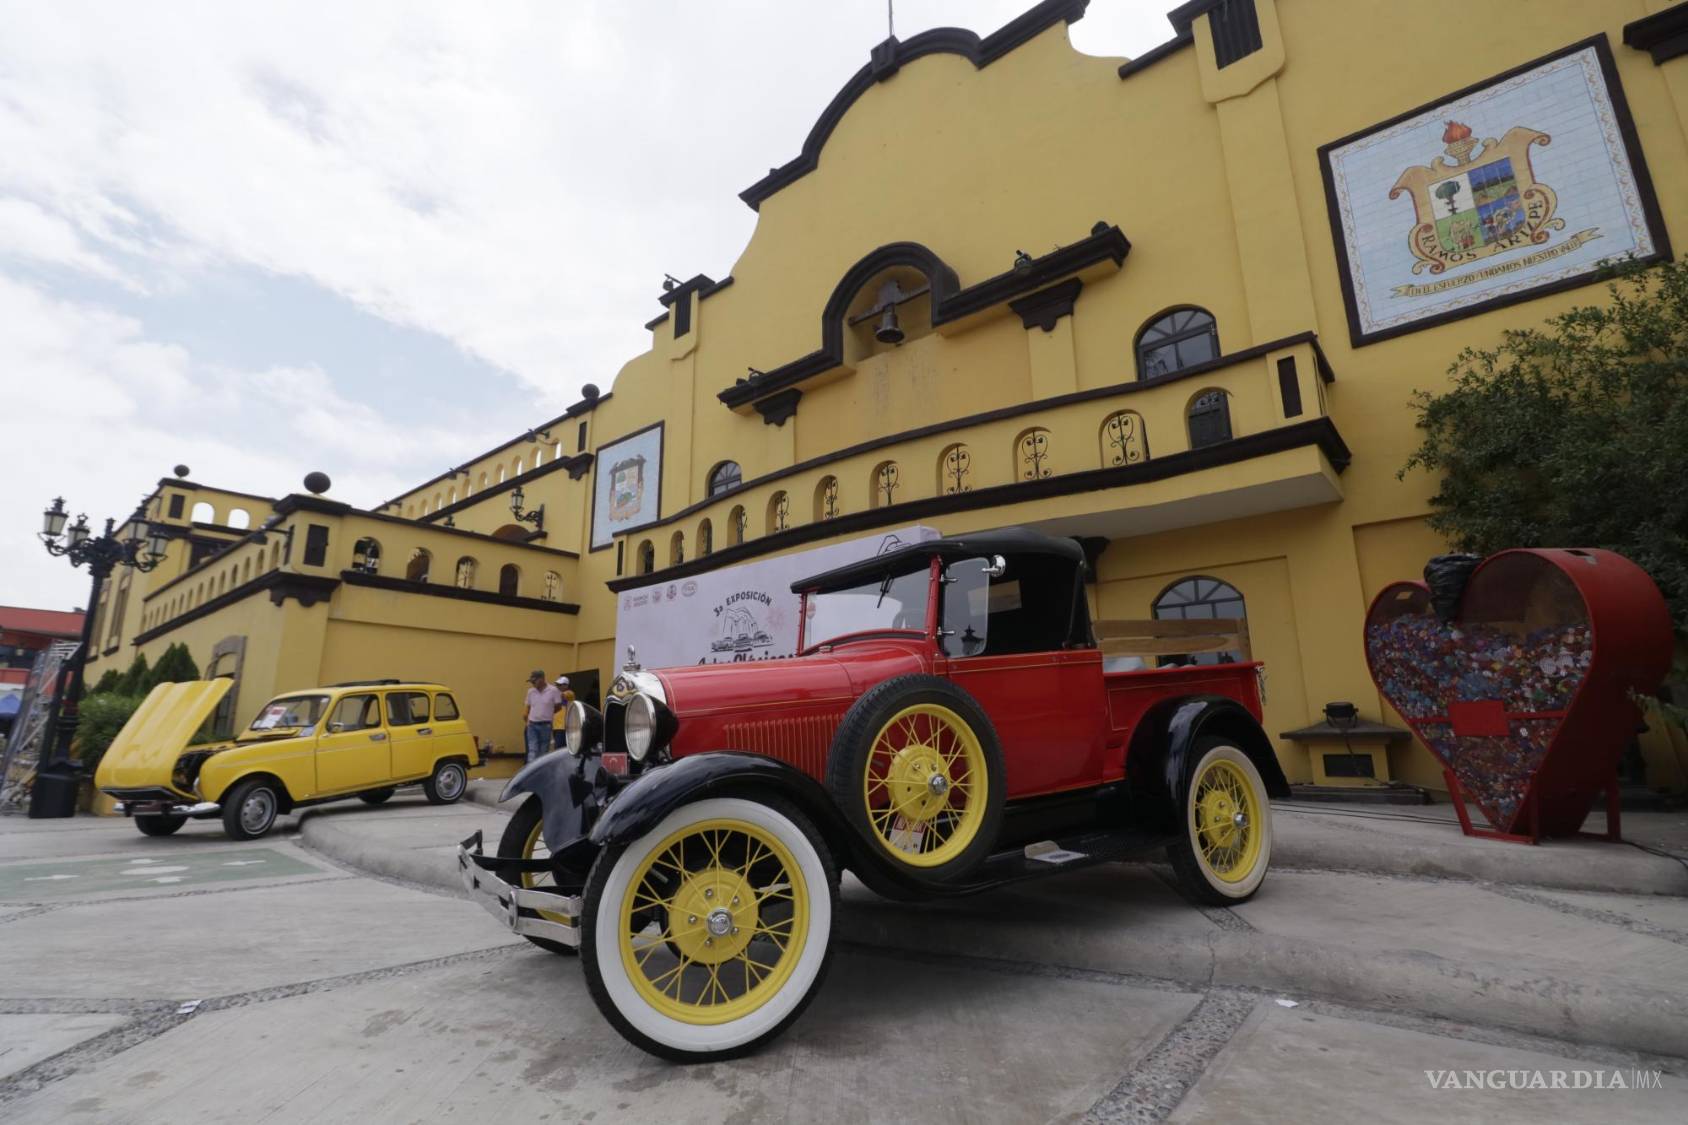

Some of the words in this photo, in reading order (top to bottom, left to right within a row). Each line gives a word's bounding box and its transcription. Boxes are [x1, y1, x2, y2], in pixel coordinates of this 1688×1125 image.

[1422, 234, 1477, 262] RAMOS
[1493, 200, 1543, 252] ARIZPE
[726, 590, 772, 606] EXPOSICIÓN
